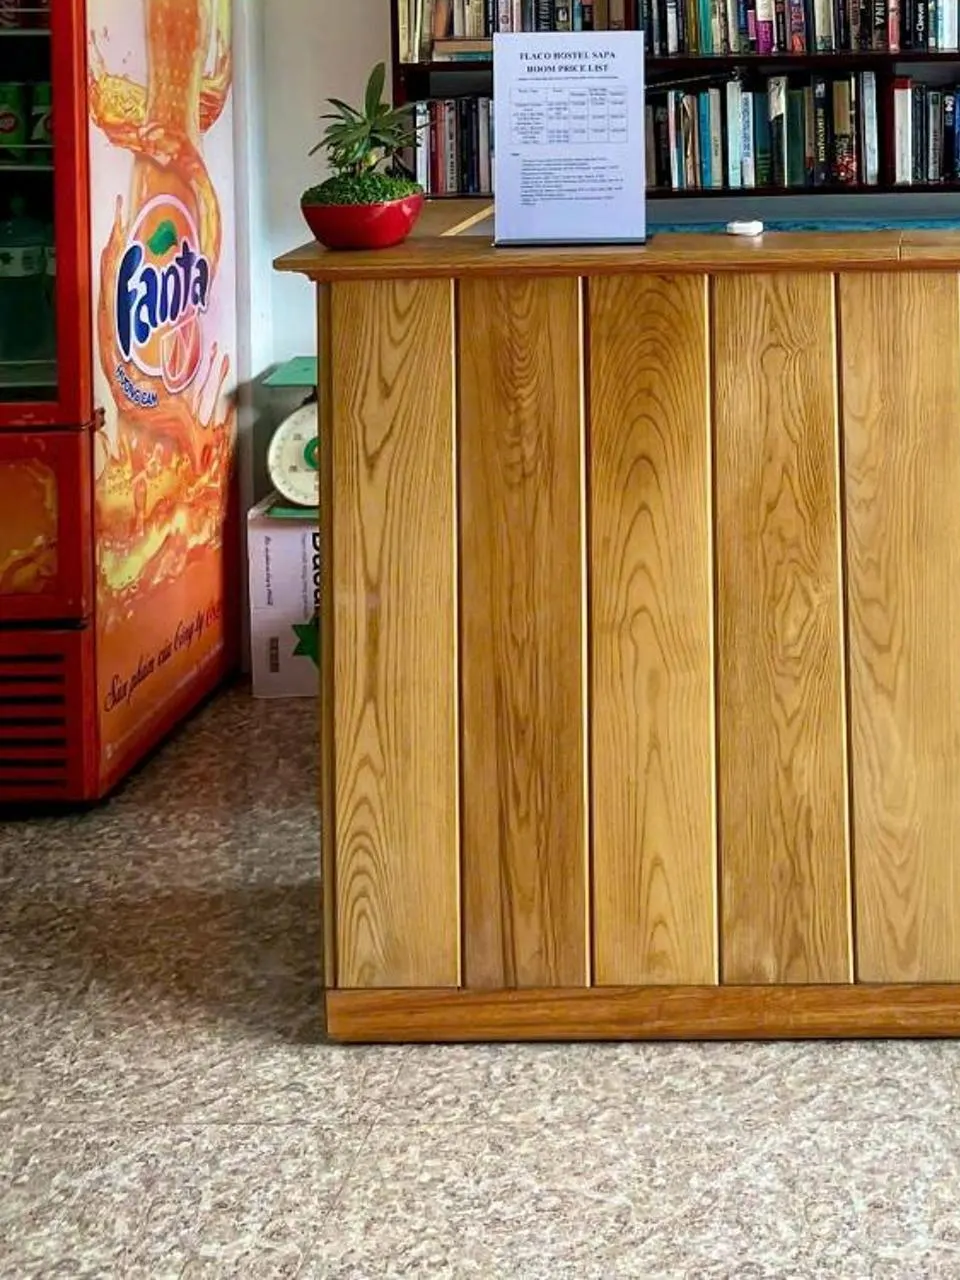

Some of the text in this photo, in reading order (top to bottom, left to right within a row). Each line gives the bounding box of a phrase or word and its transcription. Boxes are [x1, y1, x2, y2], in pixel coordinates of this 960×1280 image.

[519, 51, 616, 61] FLACO HOSTEL SAPA
[557, 64, 587, 73] PRICE
[588, 63, 609, 72] LIST
[116, 239, 209, 358] Fanta
